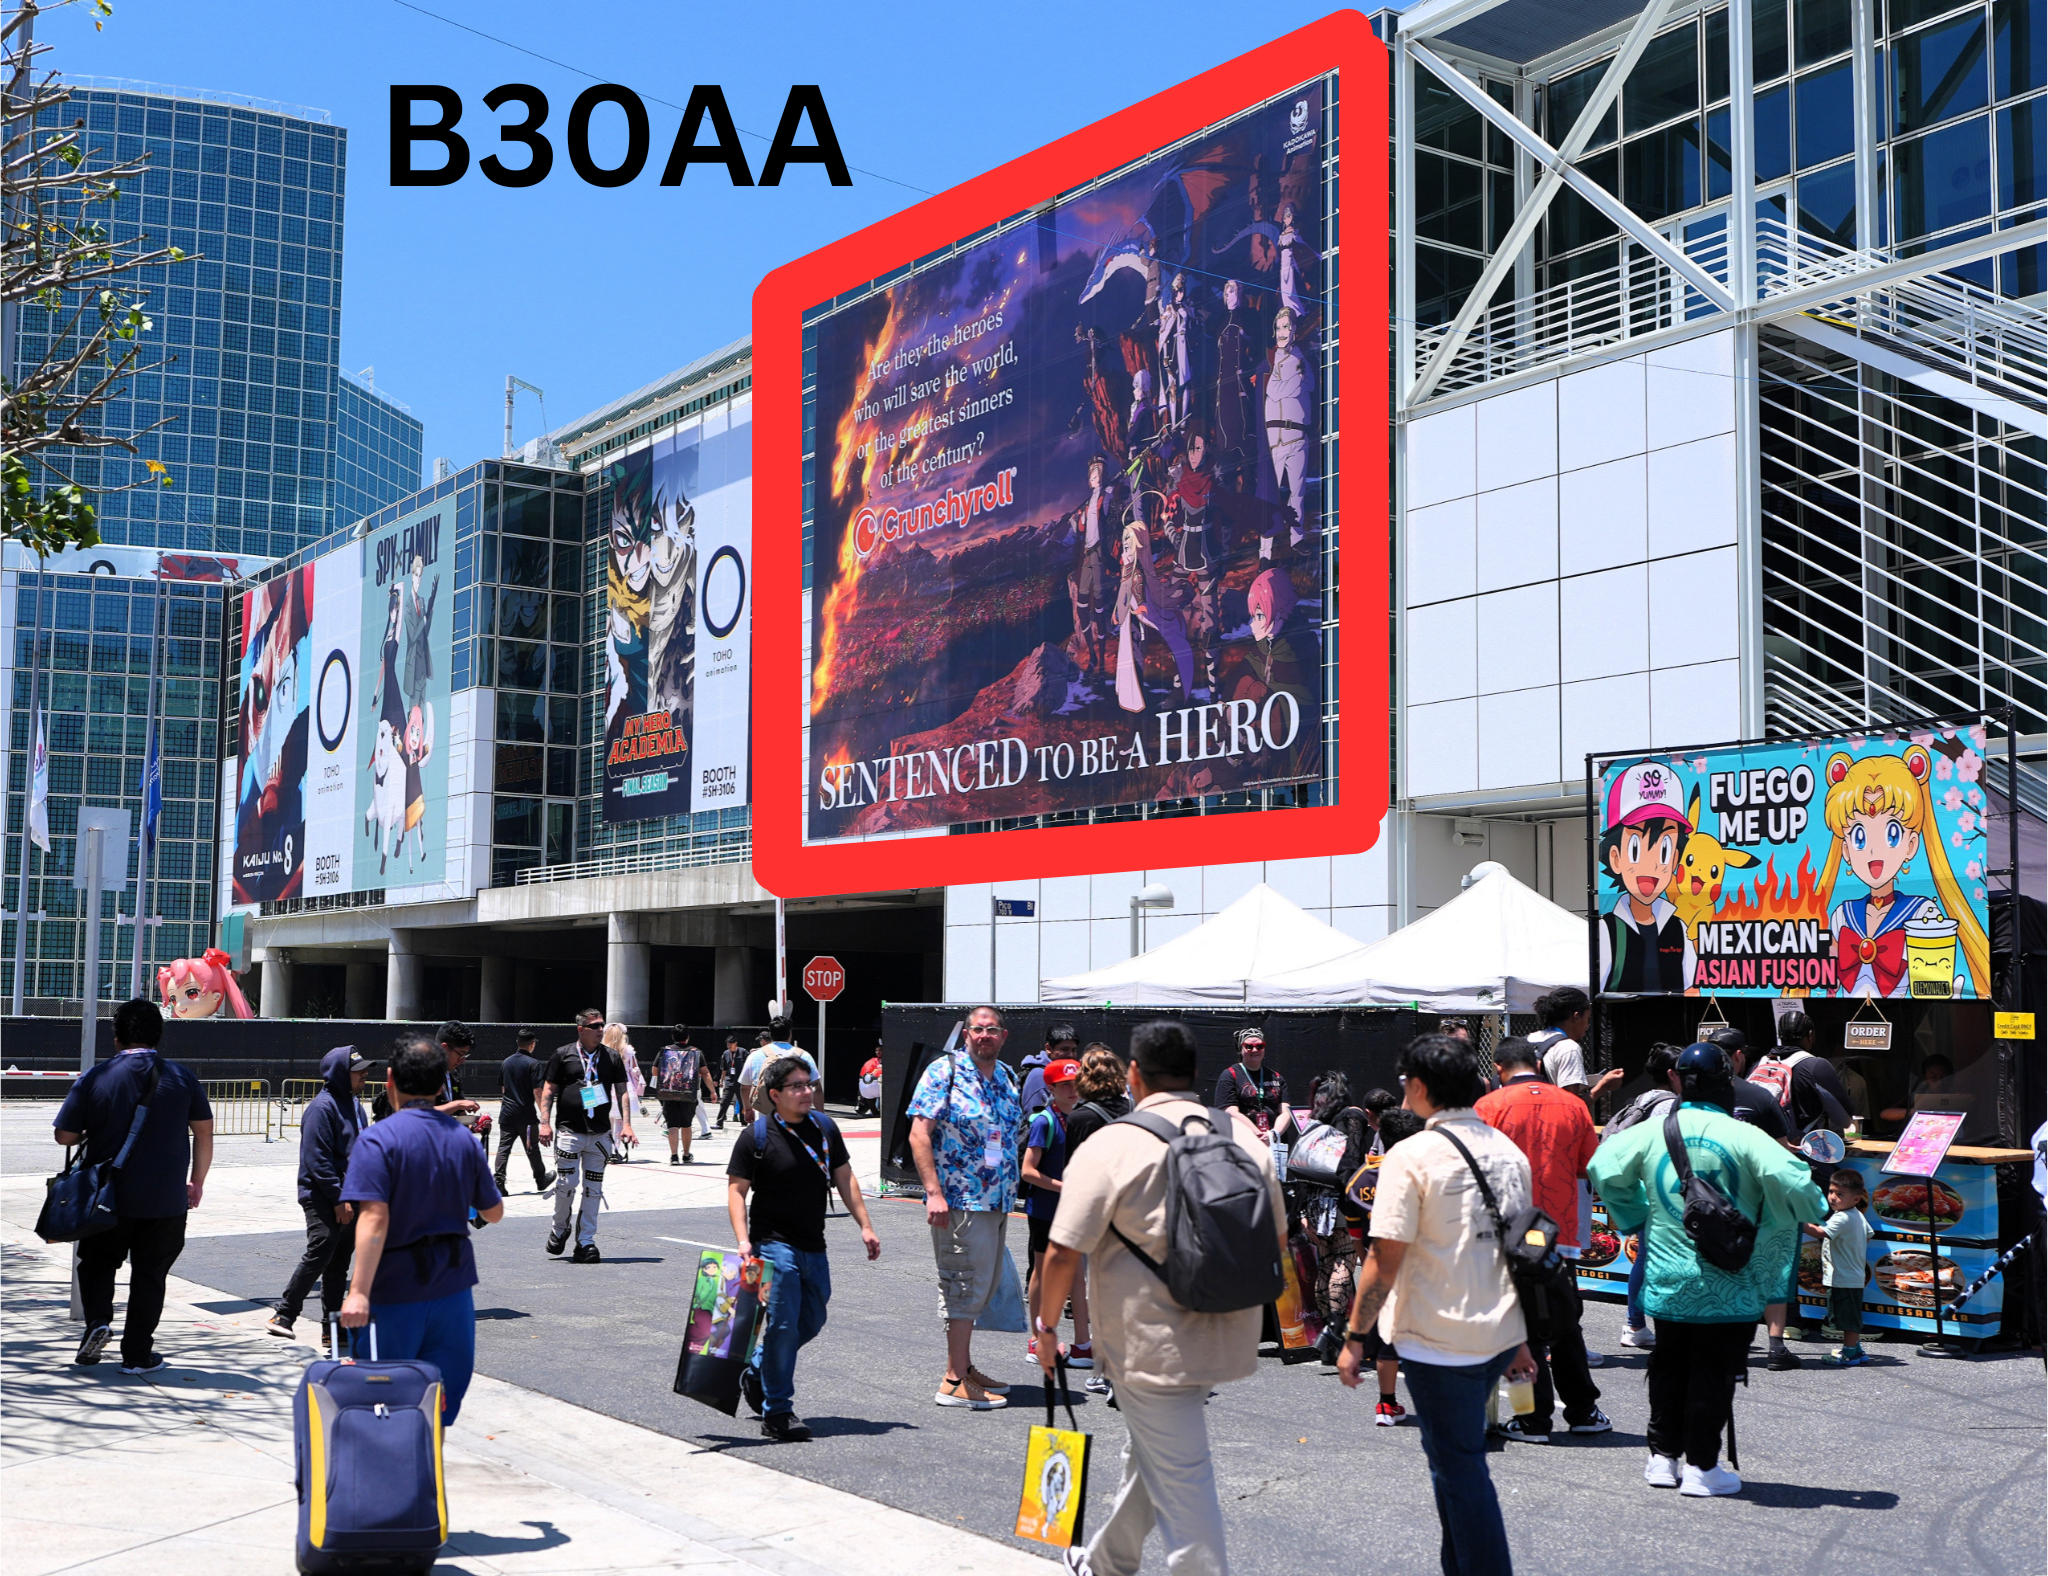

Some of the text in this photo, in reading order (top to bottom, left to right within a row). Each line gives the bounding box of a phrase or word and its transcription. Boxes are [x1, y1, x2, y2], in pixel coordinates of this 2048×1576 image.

[1282, 129, 1316, 149] KADOKAWA
[867, 311, 1003, 382] Are they the heroes
[853, 340, 1019, 424] who will save the world,
[857, 386, 1013, 460] or the greatest sinners
[880, 431, 985, 489] of the century?
[881, 469, 1013, 541] Crunchyroll
[376, 533, 397, 587] SPY
[402, 513, 441, 576] FAMILY
[712, 649, 733, 663] TOHO
[705, 664, 738, 678] animation
[624, 710, 671, 738] MY HERO
[607, 728, 687, 765] ACADEMIA
[819, 736, 1029, 811] SENTENCED
[1034, 741, 1074, 782] TO
[1080, 735, 1118, 776] BE
[1155, 691, 1300, 768] HERO
[323, 764, 339, 779] TOHO
[702, 765, 736, 784] BOOTH
[1643, 769, 1662, 788] SO
[318, 782, 344, 795] animation
[622, 772, 668, 797] FINAL SEASON
[702, 782, 736, 798] #SH-3106
[1711, 765, 1815, 808] FUEGO
[1638, 789, 1667, 800] YUMMY!
[1719, 806, 1808, 843] ME UP
[242, 851, 270, 868] KAIJU
[272, 850, 283, 864] No.
[283, 834, 293, 875] 8
[315, 854, 340, 871] BOOTH
[315, 870, 340, 886] #SH-3106
[998, 900, 1012, 910] Pico
[1699, 921, 1830, 955] MEXICAN-
[806, 970, 842, 987] STOP
[1695, 957, 1835, 986] ASIAN FUSION
[1917, 982, 1947, 996] LEMONADE
[1851, 1027, 1886, 1037] ORDER
[1689, 1140, 1711, 1148] EXPO
[1575, 1269, 1610, 1280] LGOGI
[1876, 1306, 1969, 1323] QUESADLA
